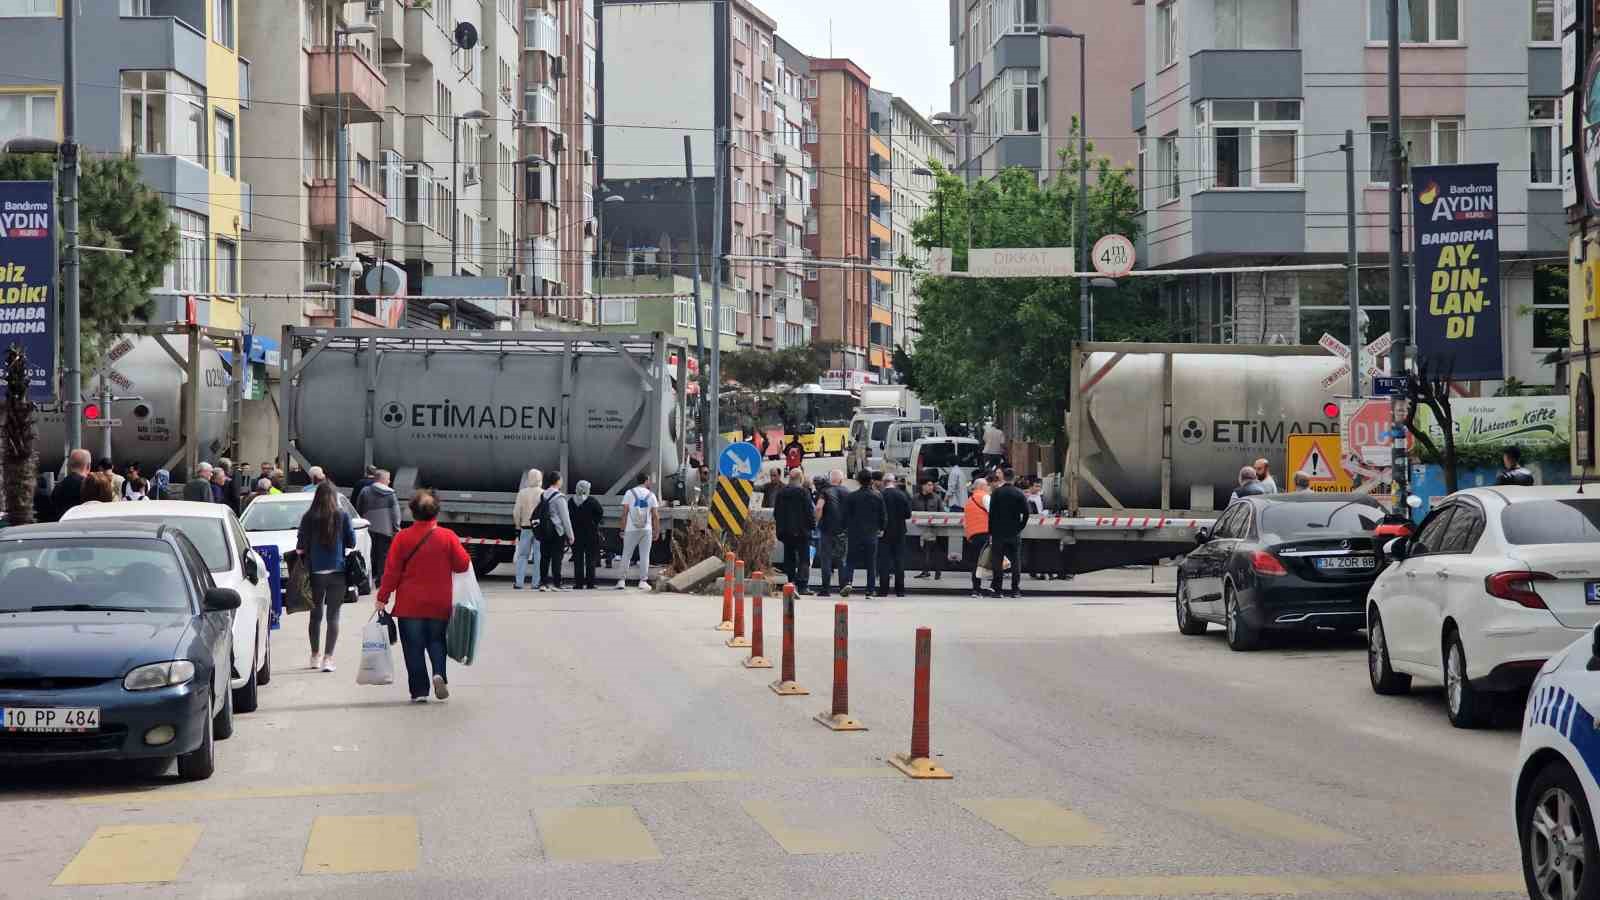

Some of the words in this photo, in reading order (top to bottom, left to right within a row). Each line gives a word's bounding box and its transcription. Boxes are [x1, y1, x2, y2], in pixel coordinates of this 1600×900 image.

[1449, 184, 1493, 194] Bandırma
[1431, 195, 1494, 221] AYDIN
[1421, 229, 1494, 245] BANDIRMA
[1438, 244, 1480, 268] AY-
[1431, 268, 1488, 293] DIN-
[1429, 291, 1491, 316] LAN-
[0, 321, 46, 334] DIRMA
[1446, 315, 1475, 339] DI
[411, 398, 557, 430] ETİMADEN
[7, 710, 26, 726] 10
[35, 710, 56, 726] PP
[64, 710, 97, 726] 484
